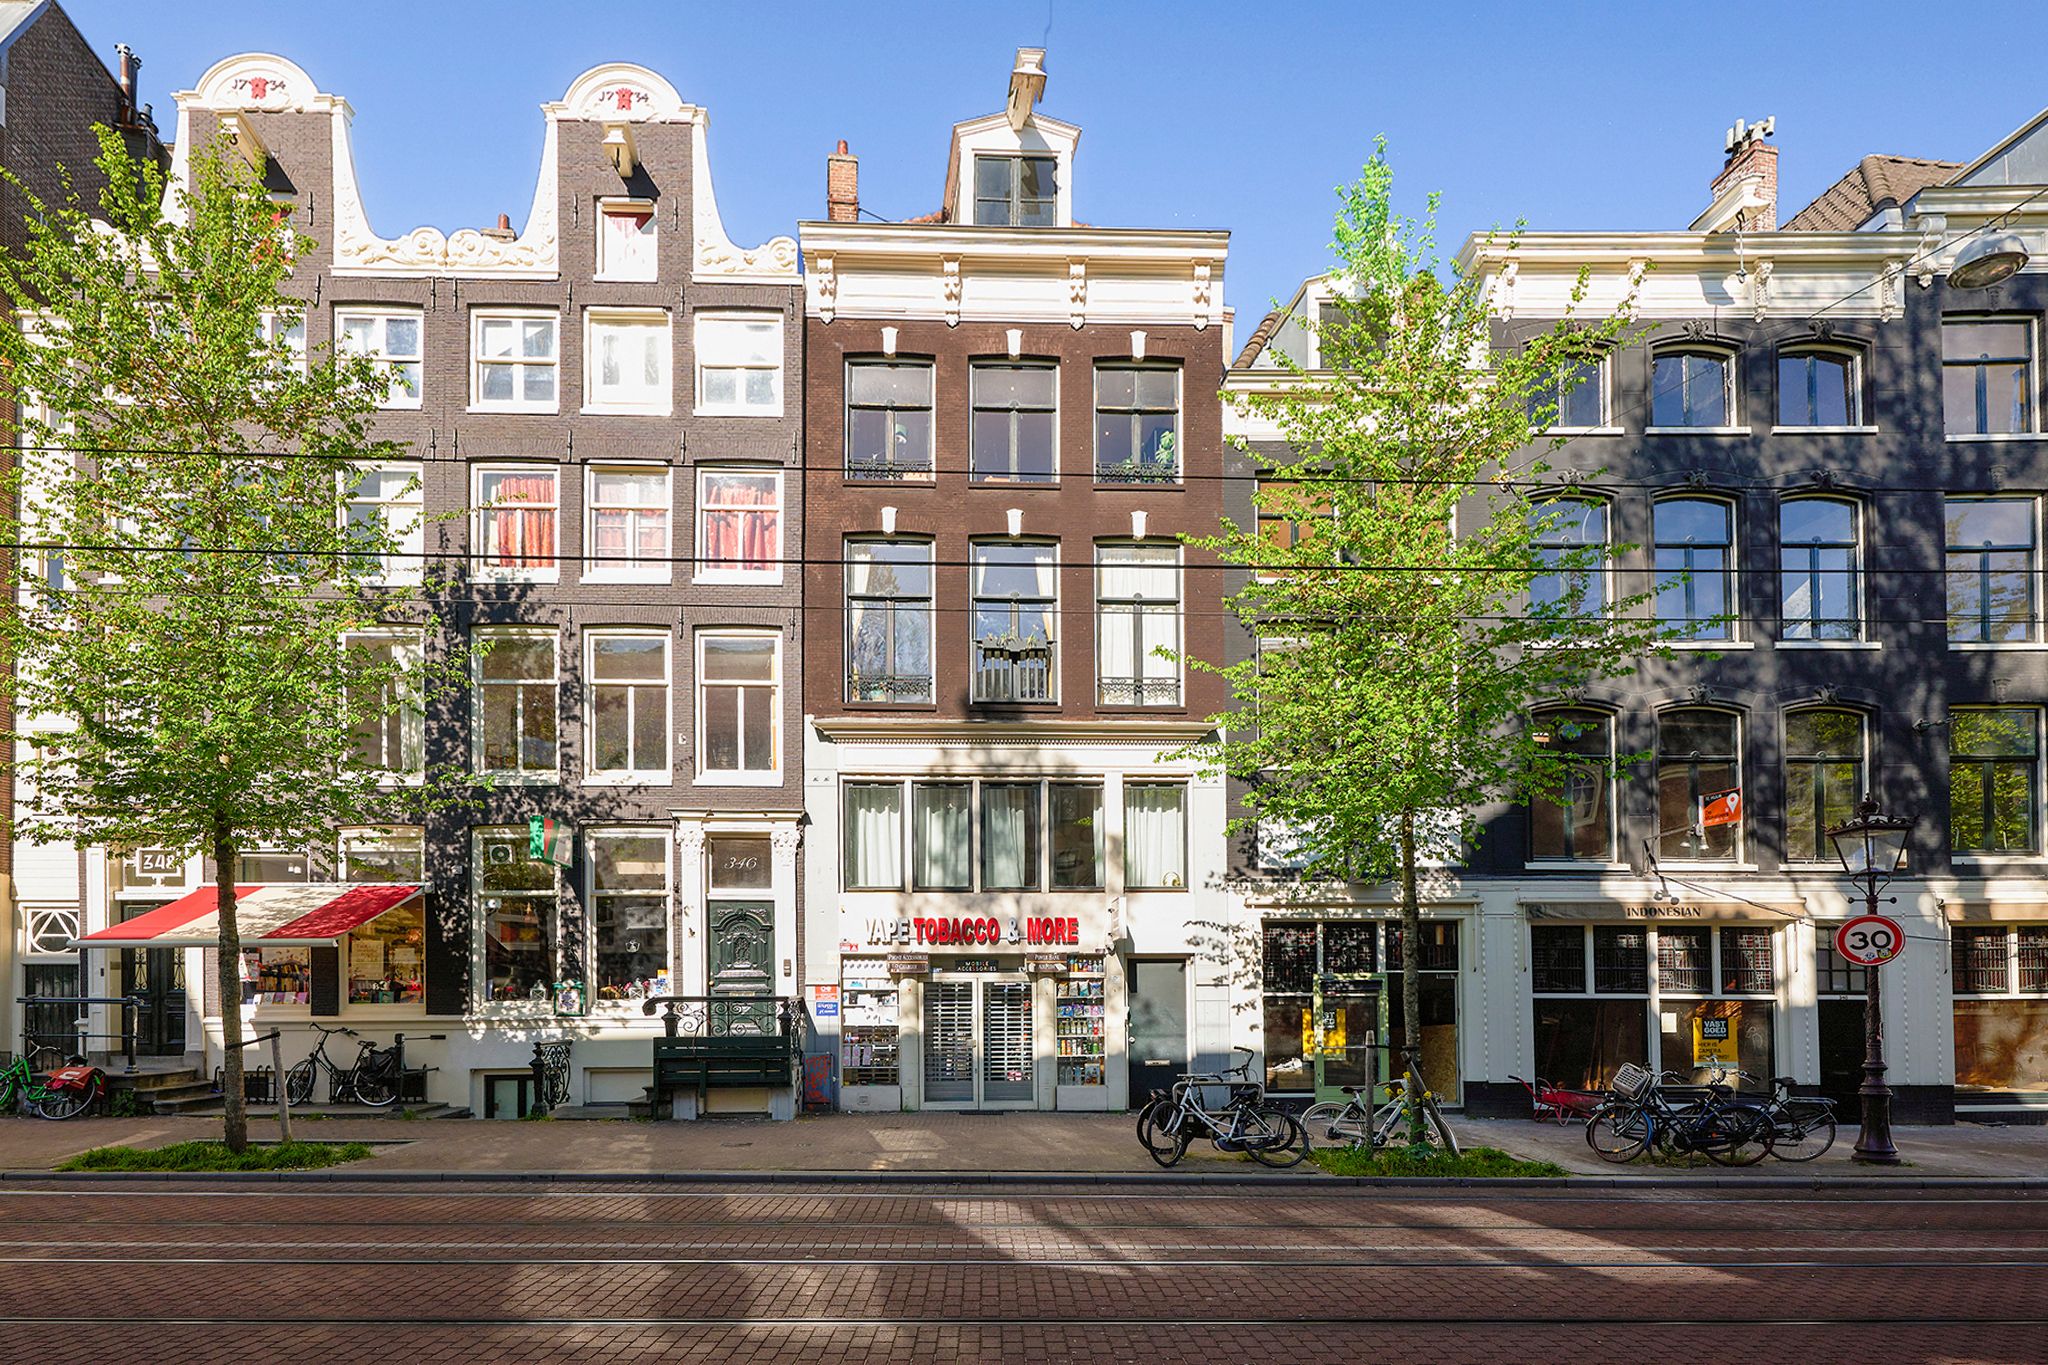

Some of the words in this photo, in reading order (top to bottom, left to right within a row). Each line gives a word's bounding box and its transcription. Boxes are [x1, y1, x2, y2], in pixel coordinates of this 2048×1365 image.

[143, 854, 176, 870] 348
[723, 856, 758, 870] 346
[1627, 907, 1701, 917] INDONESIAN
[865, 918, 910, 945] VAPE
[913, 917, 1000, 945] TOBACCO
[1007, 917, 1020, 945] &
[1027, 917, 1079, 945] MORE
[1850, 930, 1892, 950] 30
